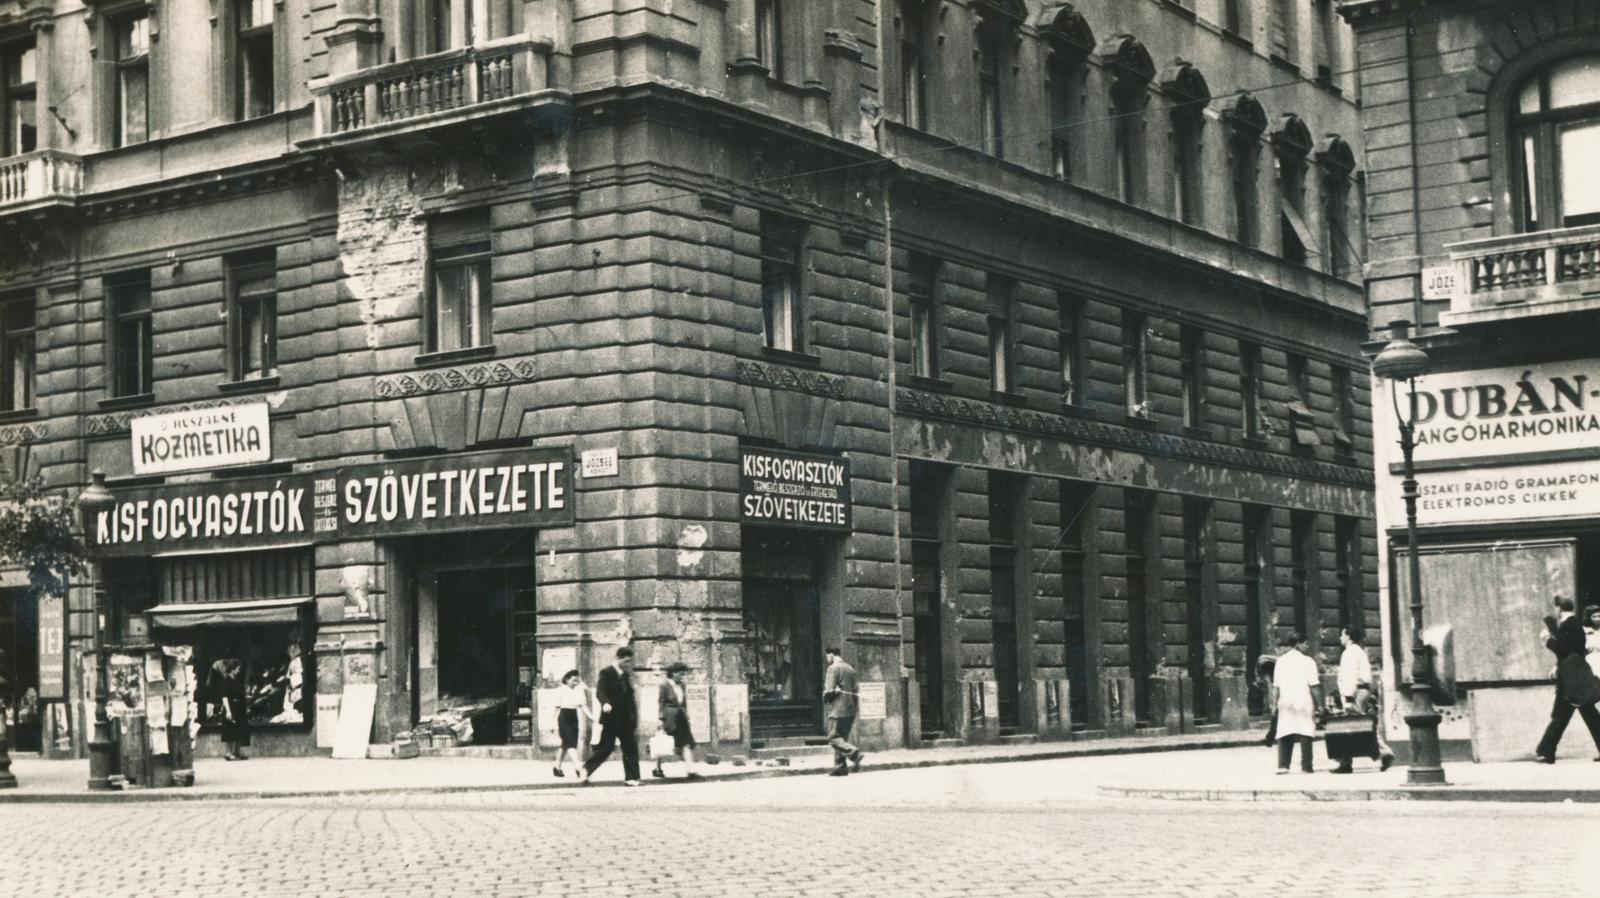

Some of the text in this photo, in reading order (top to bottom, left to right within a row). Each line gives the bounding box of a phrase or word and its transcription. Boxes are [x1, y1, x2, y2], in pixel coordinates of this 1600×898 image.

[141, 425, 260, 464] KOZMETIKA
[1417, 415, 1600, 445] ANGÓHARMONIKA
[743, 454, 844, 487] KISFOGYASZTÓK
[1418, 484, 1459, 496] SZAKI
[1515, 473, 1599, 489] GRAMAFON
[345, 462, 564, 523] SZÖVETKEZETE
[744, 493, 845, 524] SZÖVETKEZETE
[1423, 490, 1577, 510] ELEKTROMOS CIKKEK
[97, 481, 304, 544] KISFOGYASZTÓK
